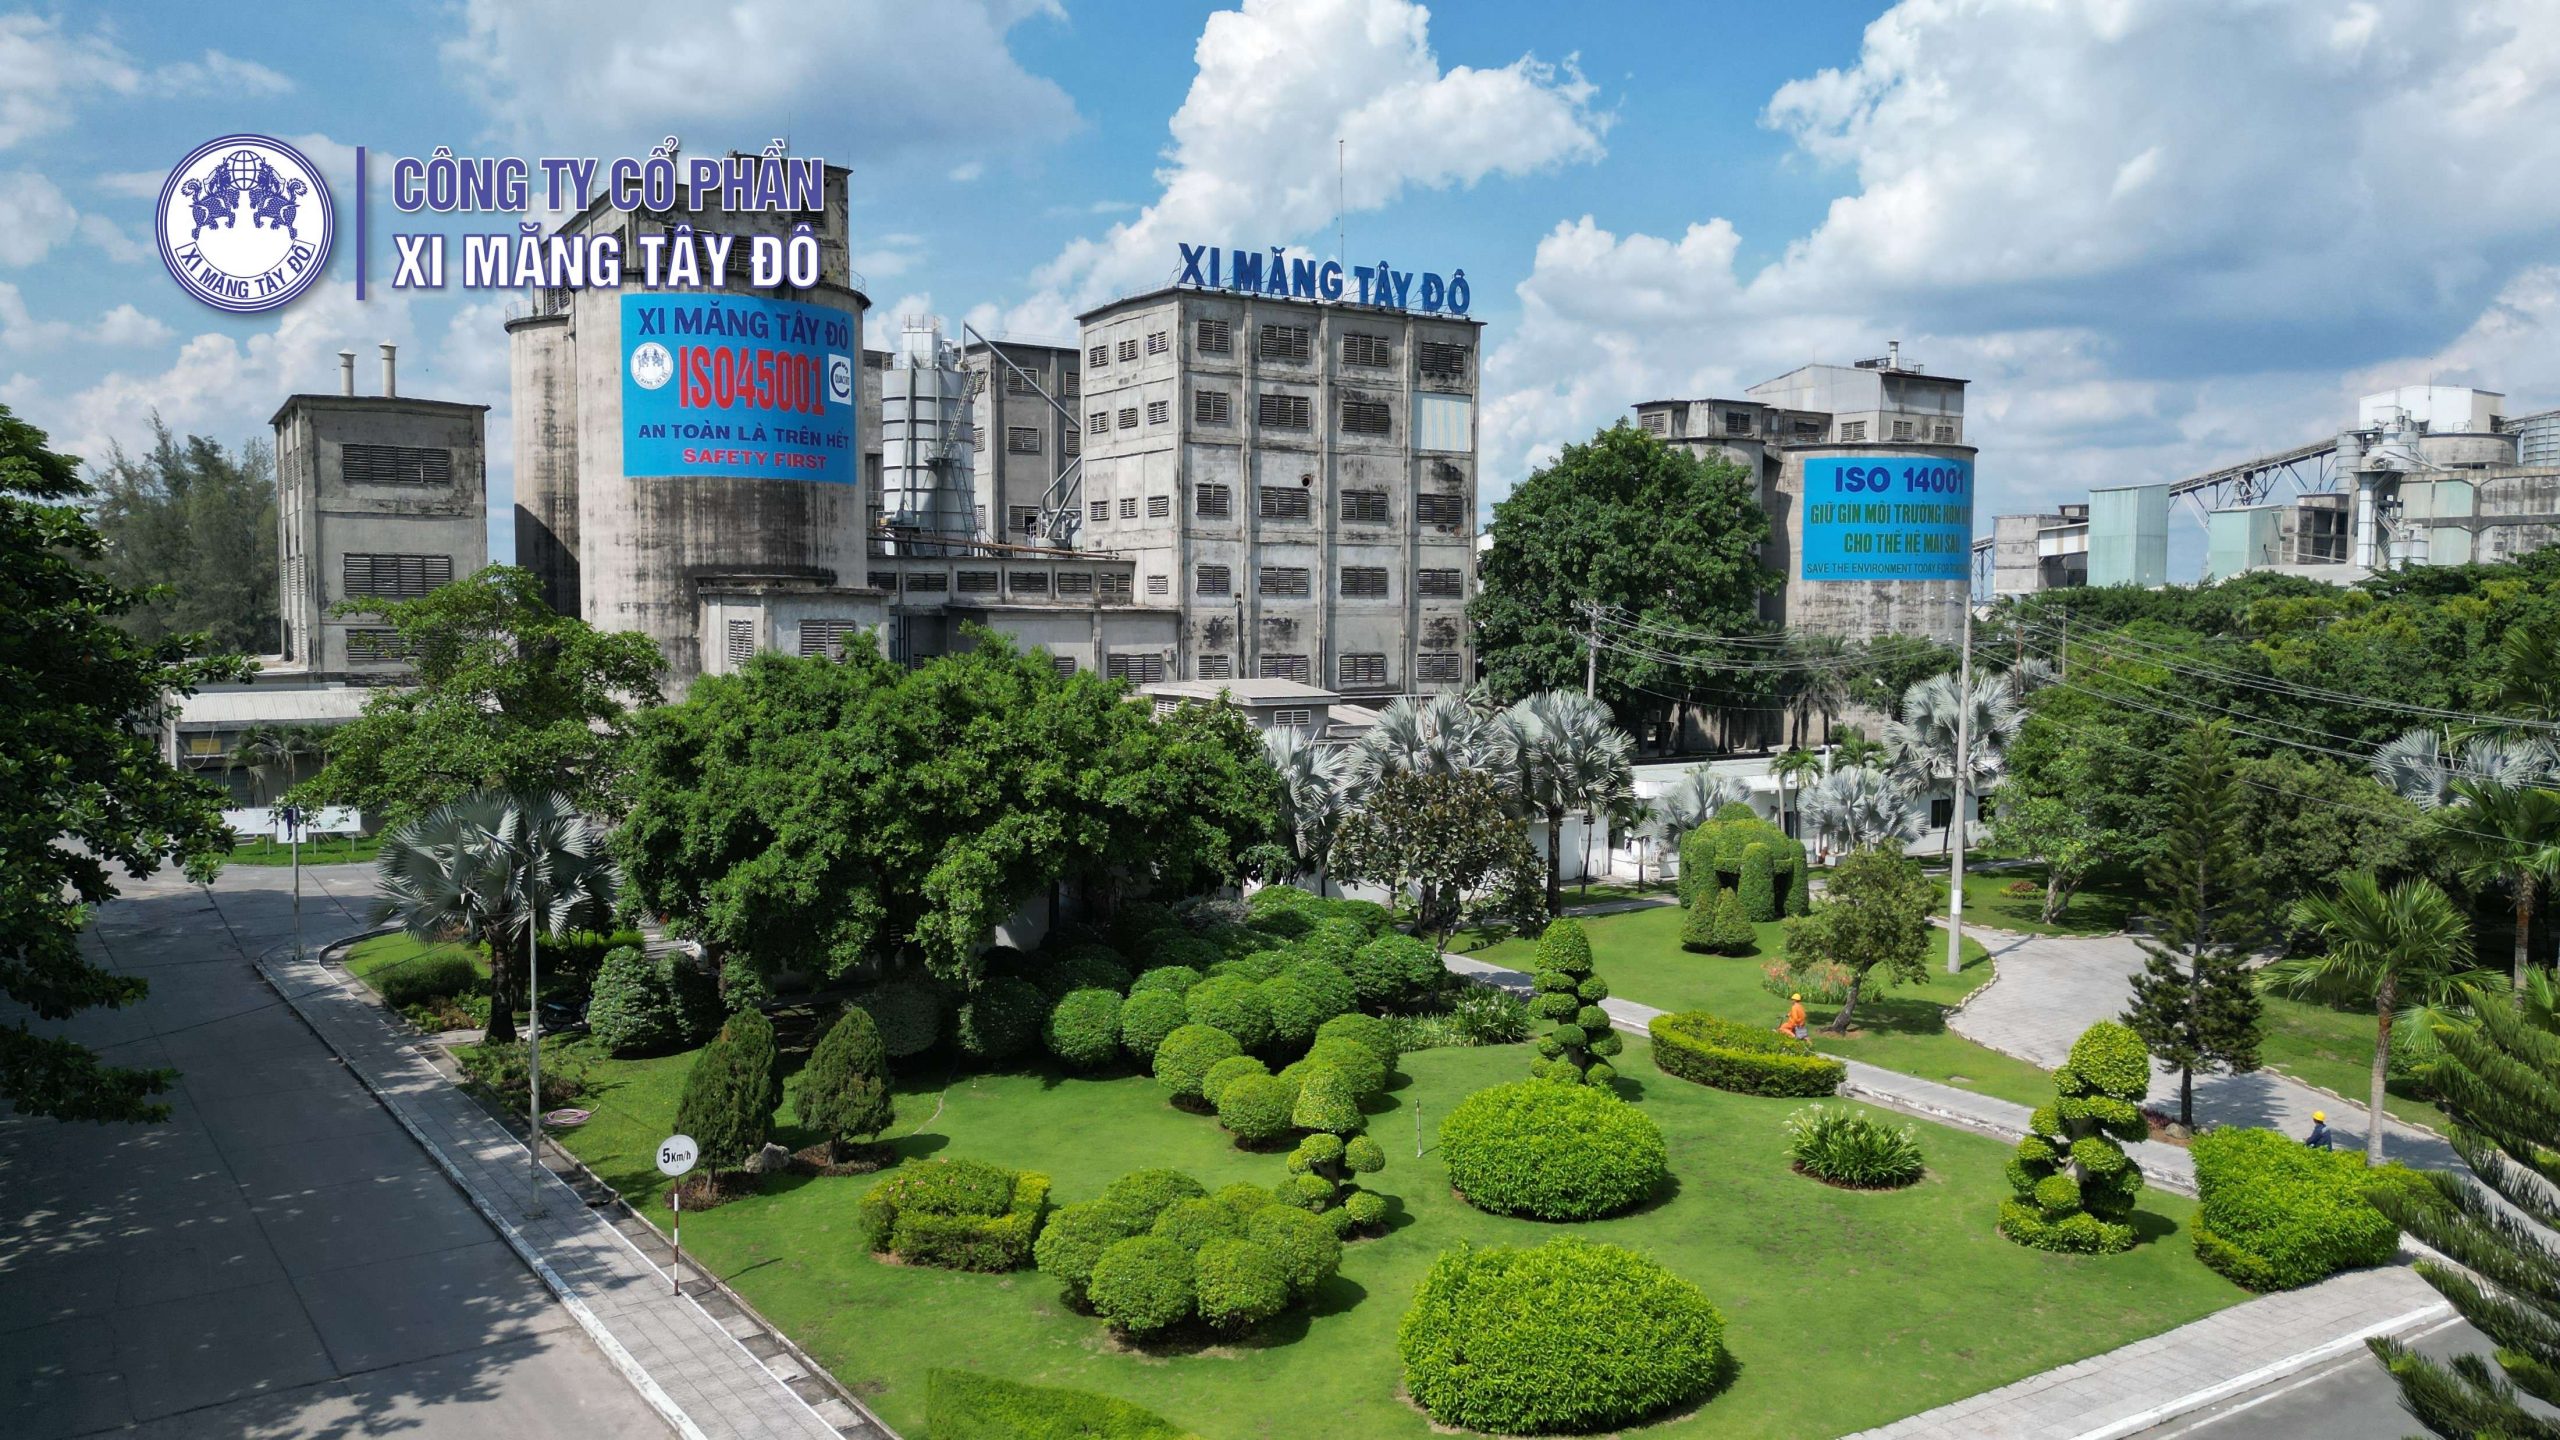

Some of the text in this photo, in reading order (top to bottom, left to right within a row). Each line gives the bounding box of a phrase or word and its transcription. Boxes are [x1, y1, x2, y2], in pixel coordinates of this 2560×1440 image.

[1178, 242, 1470, 315] XI MĂNG TÂY ĐÔ
[638, 301, 848, 349] XI MĂNG TÂY ĐÔ
[678, 345, 825, 416] ISO45001
[638, 424, 666, 439] AN
[671, 420, 730, 440] TOÀN
[738, 422, 767, 442] LÀ
[774, 424, 822, 446] TRÊN
[682, 448, 826, 470] SAFETY FIRST
[1835, 466, 1964, 494] ISO 14001
[1844, 532, 1873, 553] CHO
[1923, 533, 1943, 554] MAI
[1807, 563, 1829, 574] SAVE
[1832, 563, 1849, 574] THE
[1852, 563, 1912, 574] ENVIRONMENT
